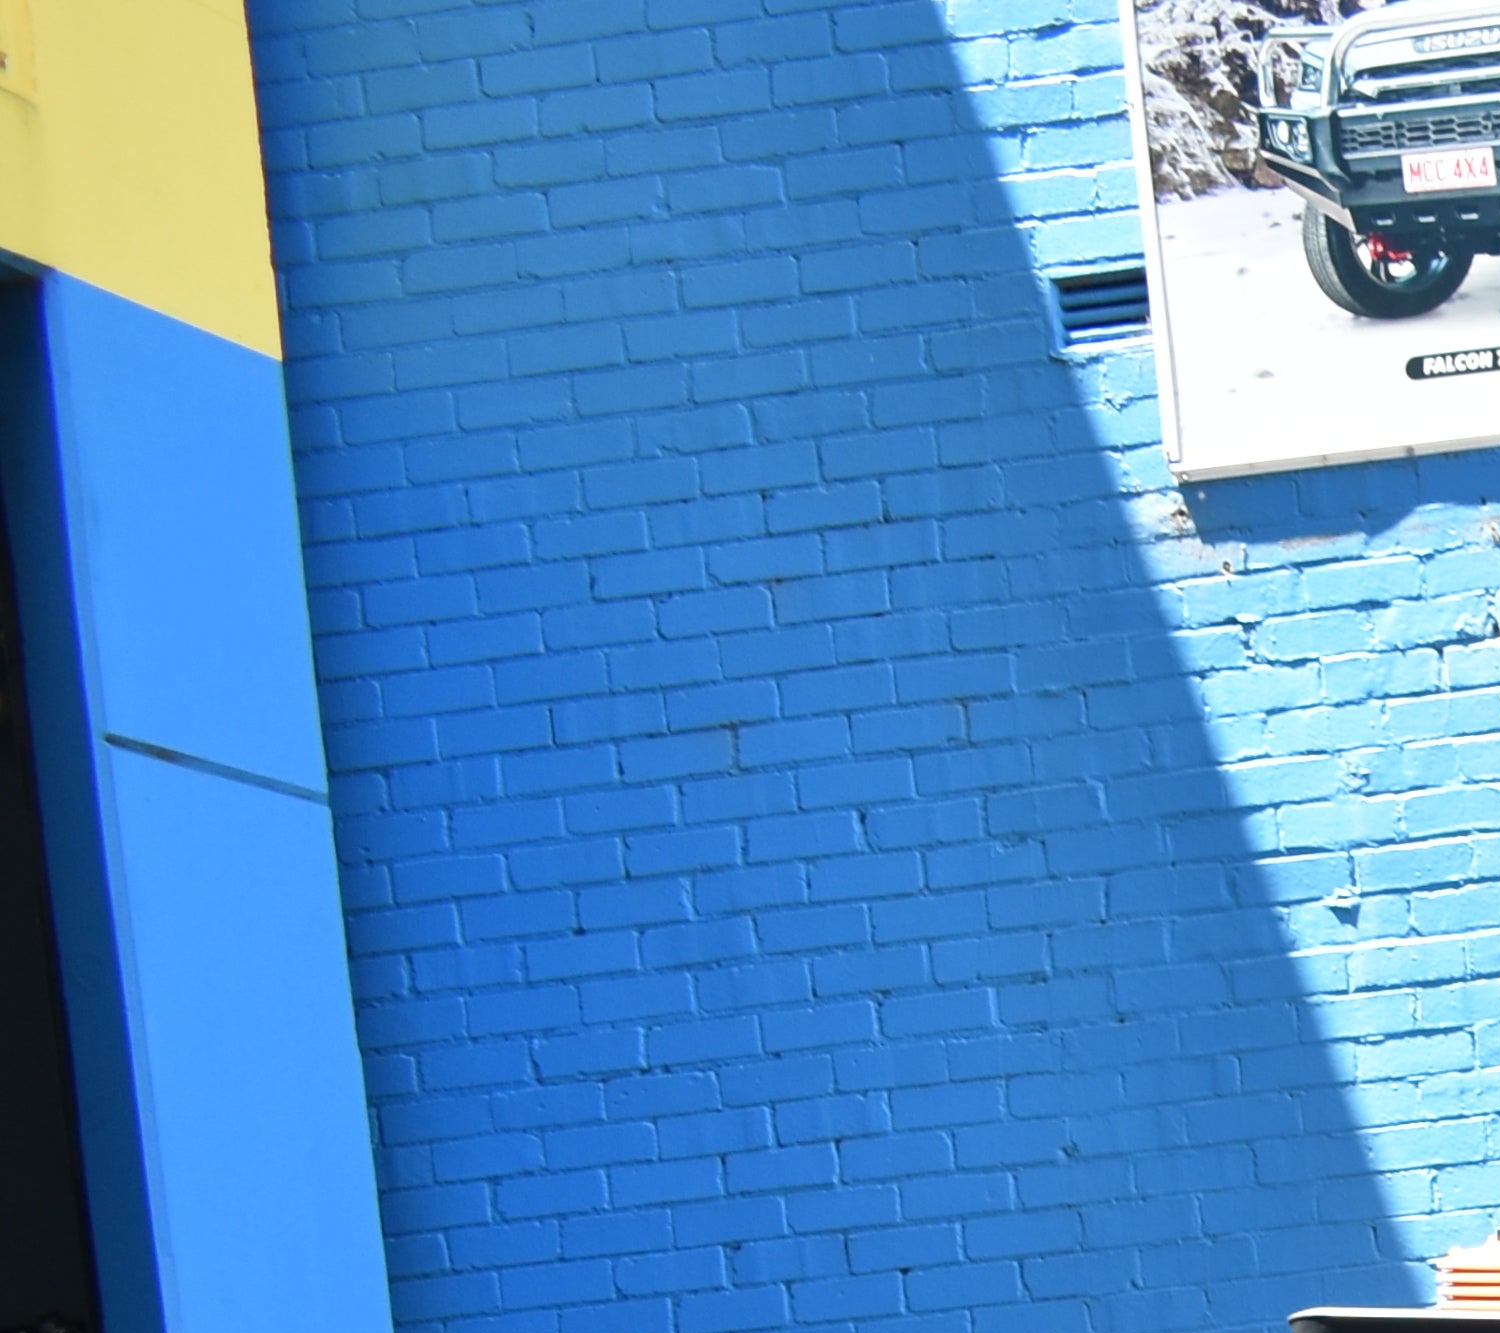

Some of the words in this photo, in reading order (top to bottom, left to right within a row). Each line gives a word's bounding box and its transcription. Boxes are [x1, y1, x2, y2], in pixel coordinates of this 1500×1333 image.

[1409, 159, 1445, 183] MCC
[1454, 156, 1490, 179] 4X4
[1423, 350, 1494, 376] FALCON
